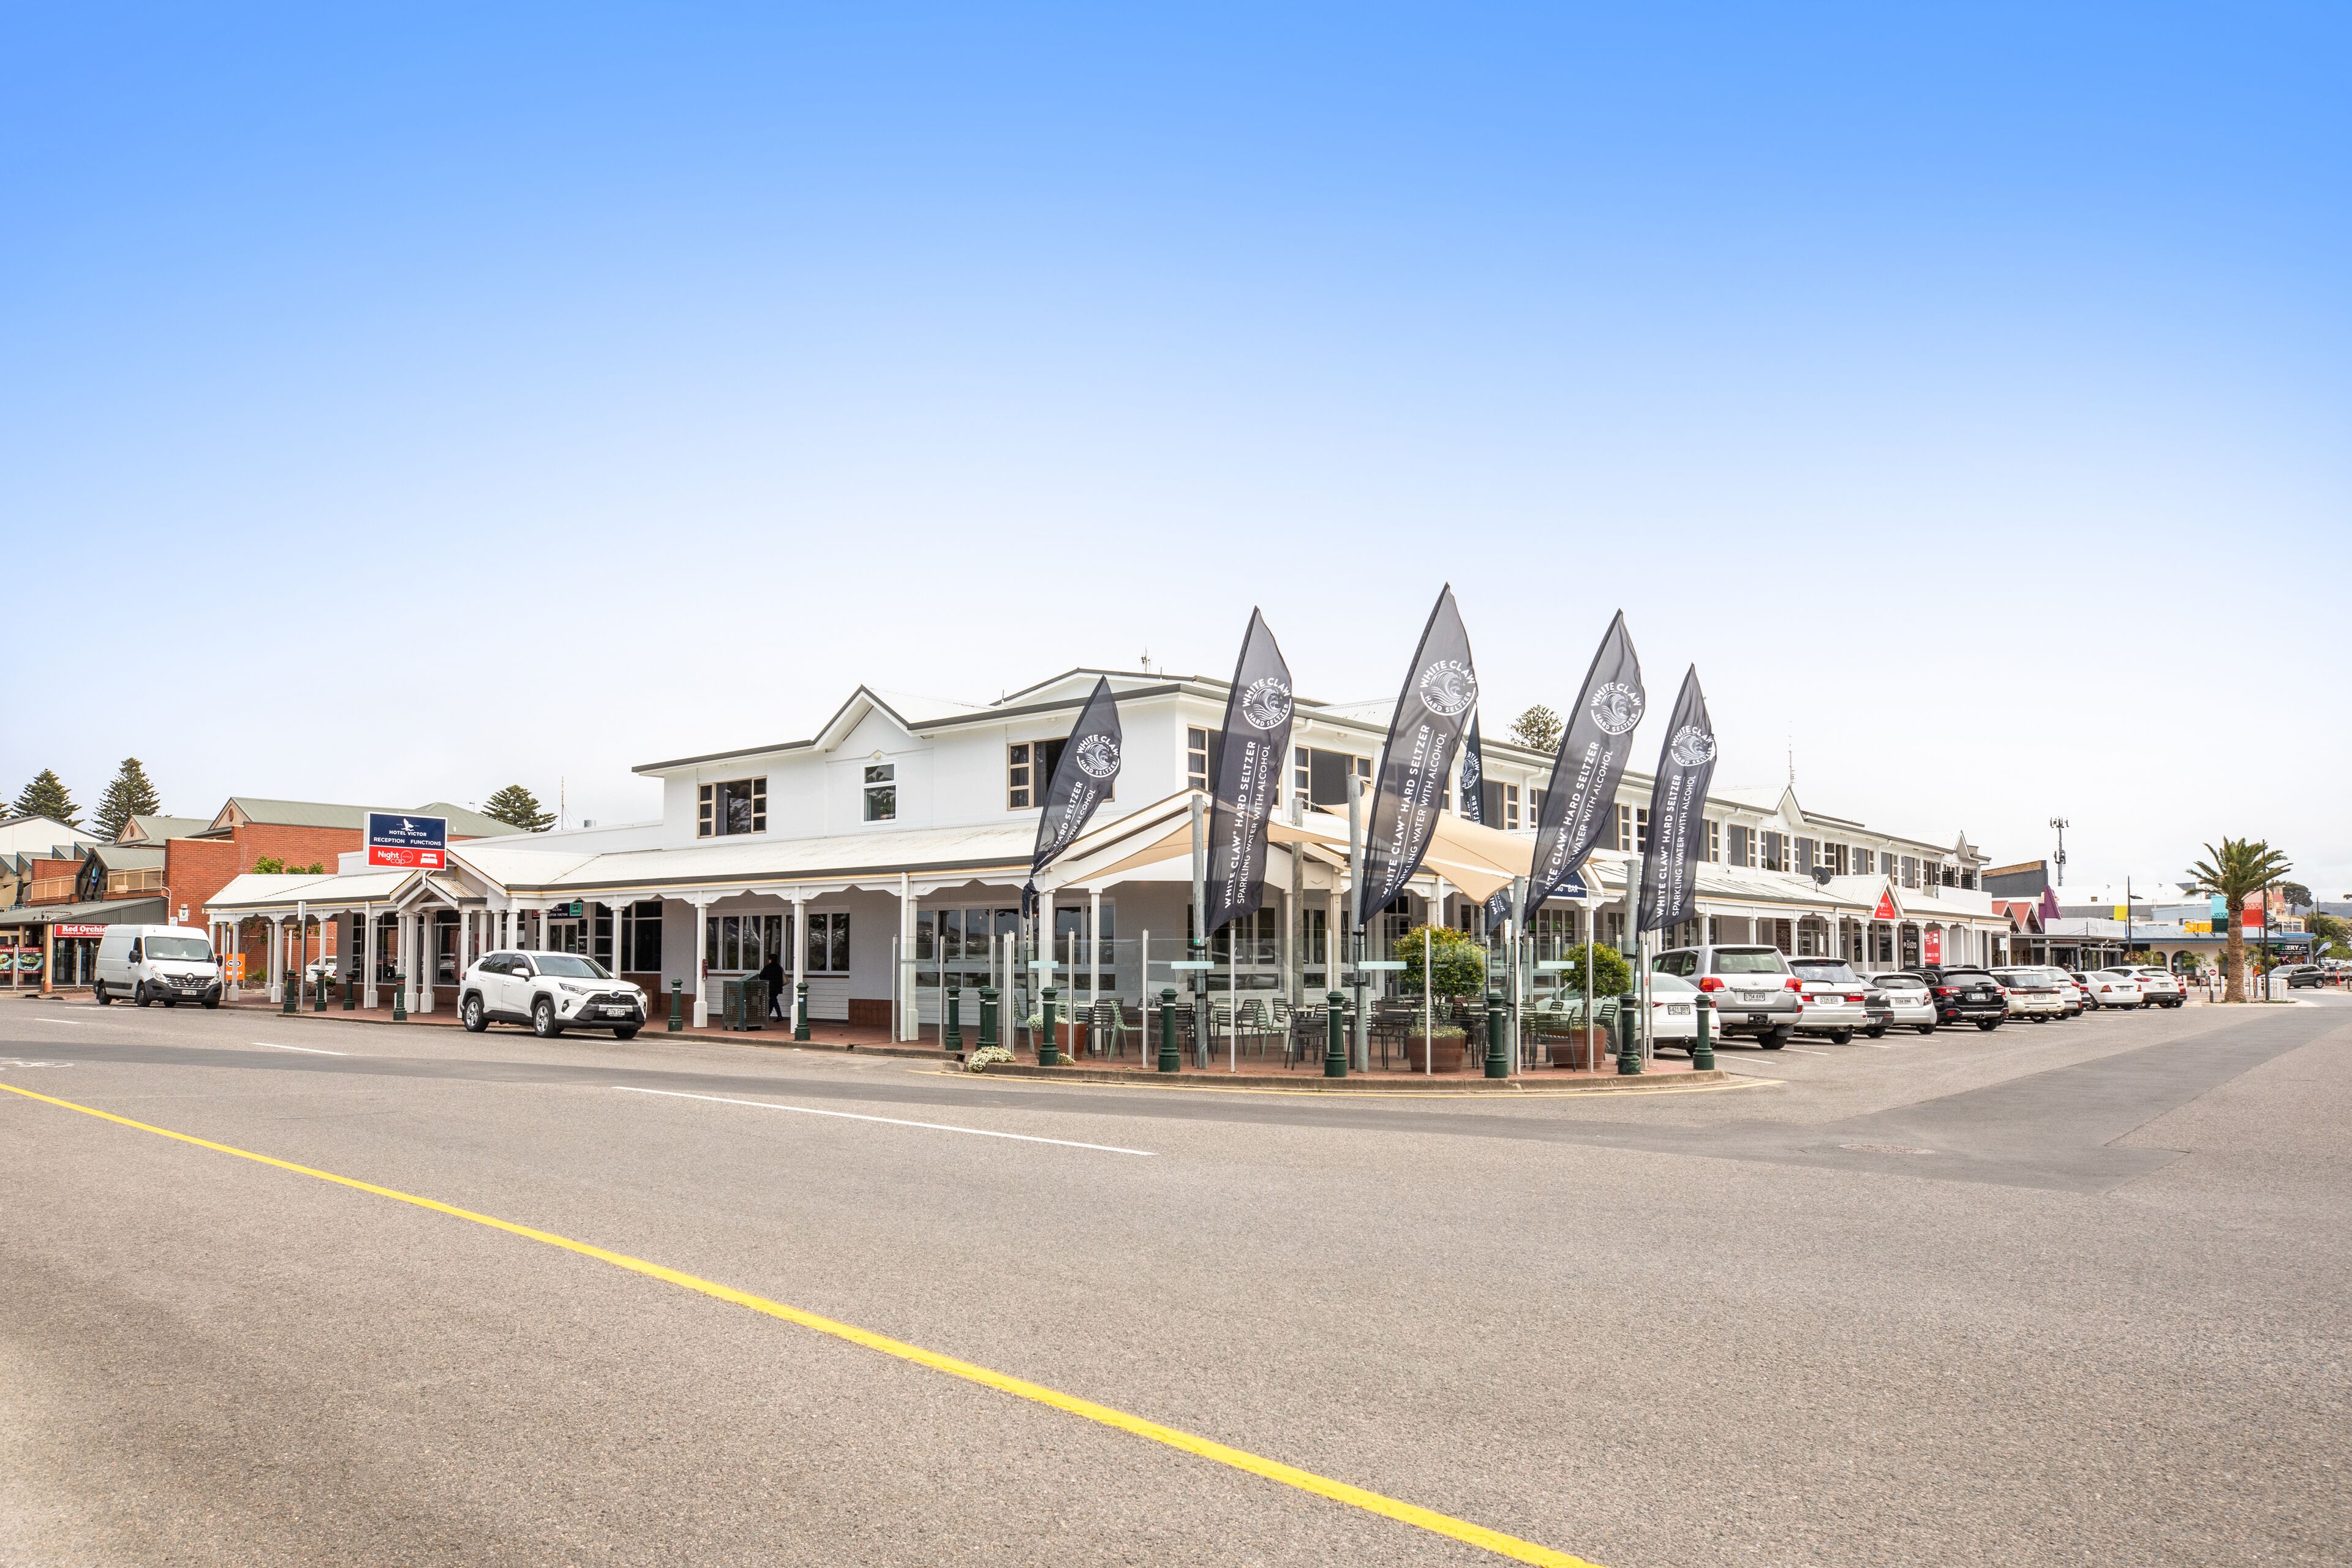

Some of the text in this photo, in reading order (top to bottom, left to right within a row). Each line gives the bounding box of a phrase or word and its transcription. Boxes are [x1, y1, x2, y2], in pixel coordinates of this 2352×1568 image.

[1420, 660, 1476, 688] WHITE CLAW
[1242, 677, 1291, 707] WHITE CLAW
[1425, 692, 1472, 712] HARD SELTZER
[1591, 682, 1642, 706] WHITE CLAW
[1248, 703, 1289, 726] HARD SELTZER
[1596, 713, 1637, 732] HARD SELTZER
[1077, 734, 1119, 756] WHITE CLAW
[1671, 725, 1714, 746] WHITE CLAW
[1080, 759, 1117, 775] HARD SELTZER
[1240, 741, 1256, 791] SELTZER
[1400, 779, 1415, 812] HARD
[1409, 725, 1430, 775] SELTZER
[1675, 753, 1689, 764] HARD
[1412, 809, 1427, 843] WATER
[1420, 780, 1434, 807] WITH
[1428, 733, 1447, 779] ALCOHOL
[1563, 793, 1581, 825] HARD
[1576, 742, 1599, 790] SELTZER
[1667, 775, 1681, 812] SELTZER
[1054, 823, 1069, 847] HARD
[1065, 781, 1084, 820] SELTZER
[1076, 789, 1096, 825] ALCOHOL
[1235, 794, 1247, 827] HARD
[1572, 750, 1613, 856] WATER WITH ALCOHOL
[1237, 745, 1270, 904] SPARKLING WATER WITH ALCOHOL
[1662, 815, 1673, 843] HARD
[378, 850, 399, 861] Night
[1672, 775, 1697, 916] SPARKLING WATER WITH ALCOHOL
[1225, 872, 1235, 908] WHITE
[1567, 884, 1578, 893] BAR
[1656, 883, 1666, 918] WHITE
[2183, 922, 2212, 933] SUB
[1907, 940, 1917, 949] Bistro
